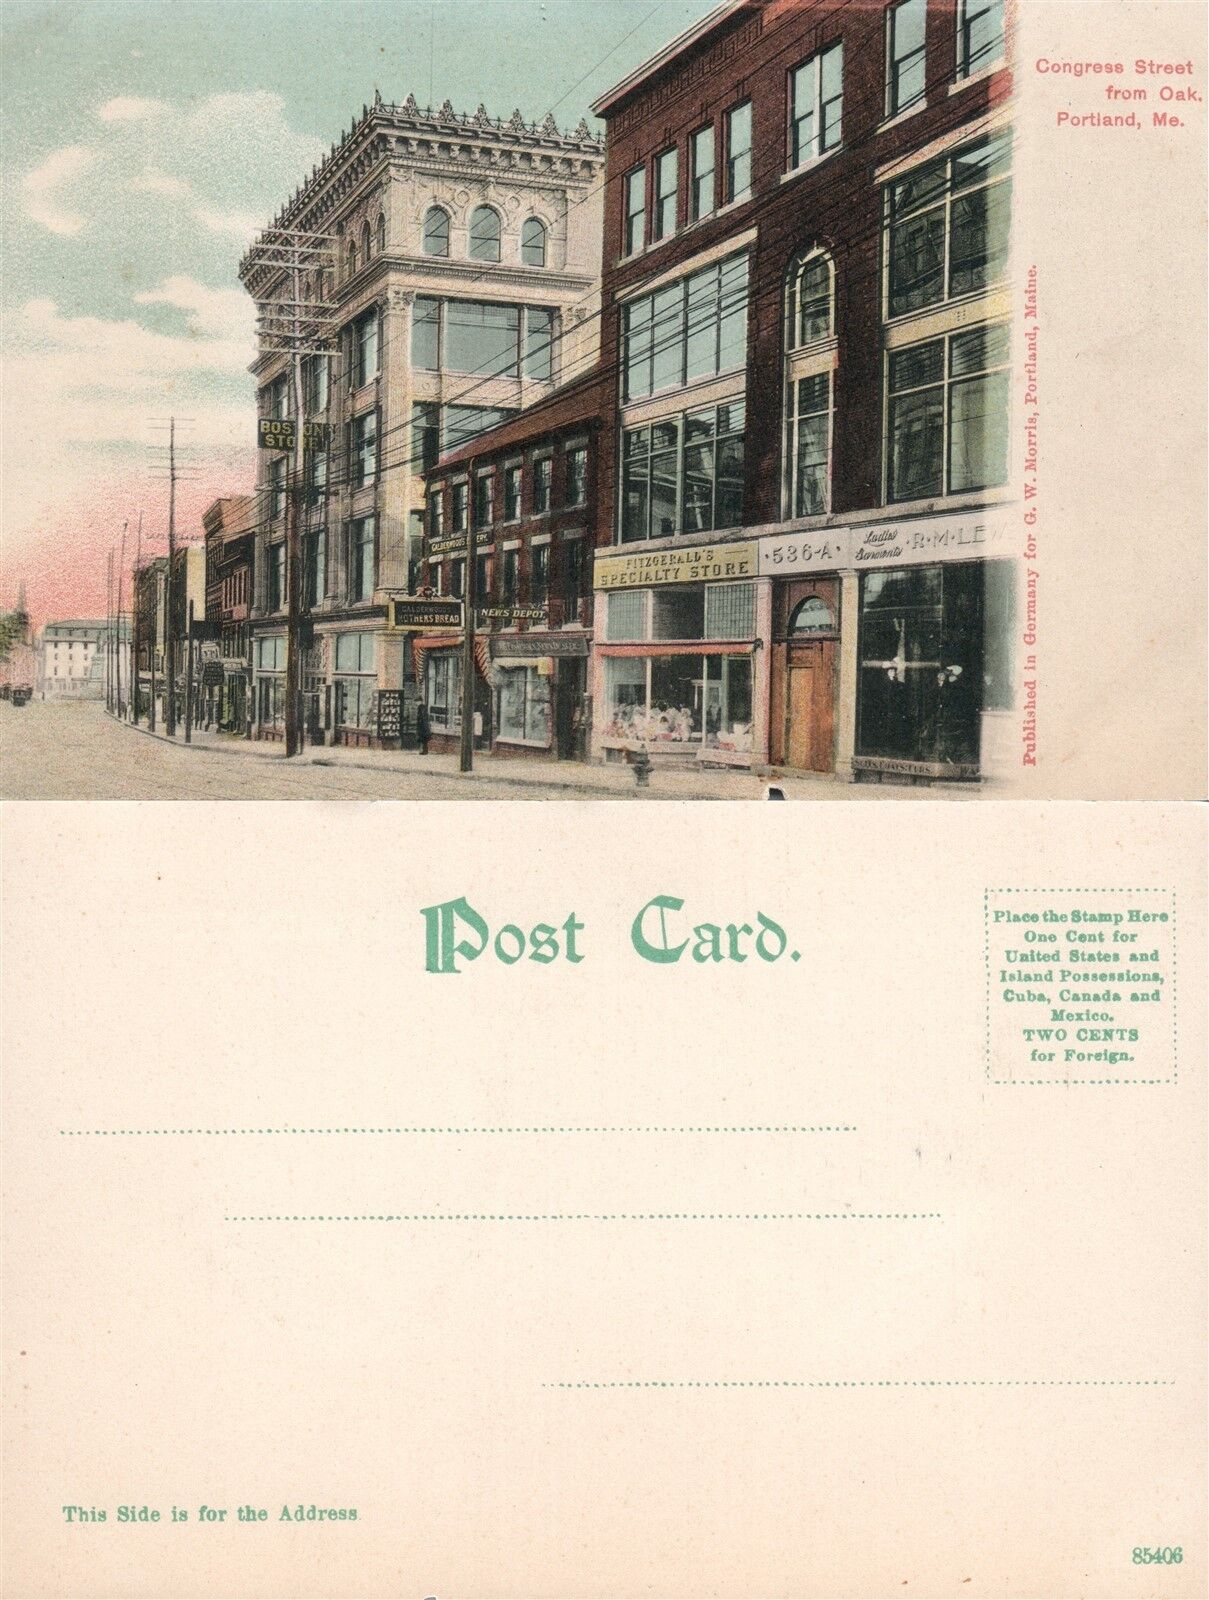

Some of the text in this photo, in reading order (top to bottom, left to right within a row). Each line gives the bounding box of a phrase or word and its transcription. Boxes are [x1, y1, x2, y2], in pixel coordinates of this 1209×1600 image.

[626, 549, 714, 570] FITZGERALD'S
[600, 561, 749, 586] SPECIALTY STORE
[435, 615, 460, 624] BREAD
[481, 608, 510, 617] NEWS
[993, 910, 1168, 926] Place the Stamp Here
[420, 895, 801, 974] Post Card.
[1024, 930, 1138, 943] One Cent for
[1005, 949, 1159, 963] United States and
[1000, 969, 1164, 985] Island Possessions,
[1003, 989, 1160, 1004] Cuba, Canada and
[1051, 1009, 1114, 1022] Mexico.
[1023, 1028, 1138, 1042] TWO CENTS
[1031, 1049, 1134, 1064] for Foreign.
[63, 1506, 106, 1522] This
[117, 1506, 160, 1522] Side
[171, 1506, 188, 1522] is
[199, 1505, 227, 1522] for
[237, 1505, 268, 1522] the
[1132, 1547, 1183, 1565] 85406
